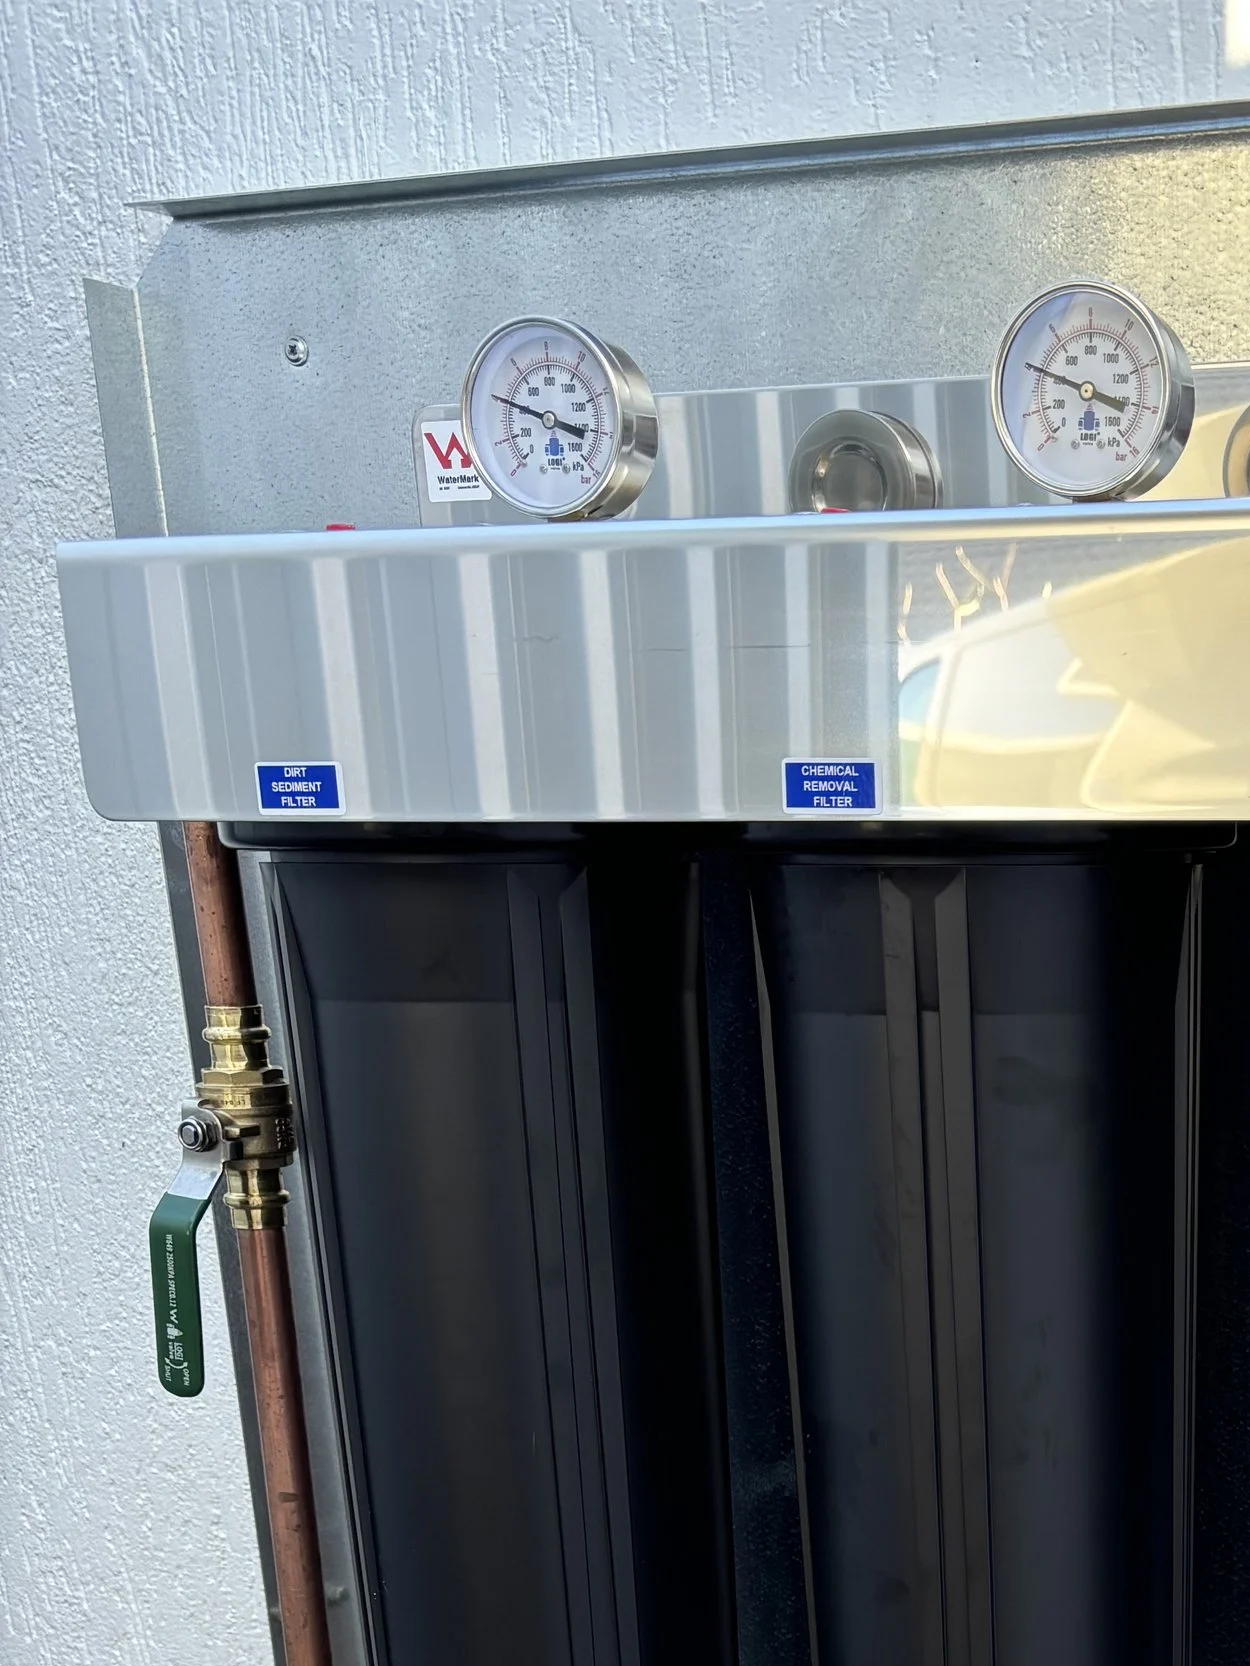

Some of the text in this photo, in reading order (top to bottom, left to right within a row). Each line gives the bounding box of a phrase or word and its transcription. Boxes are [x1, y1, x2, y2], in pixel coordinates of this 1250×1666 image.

[1084, 345, 1097, 356] 800
[1066, 355, 1078, 366] 600
[1103, 353, 1119, 364] 1000
[544, 377, 556, 386] 800
[1112, 373, 1129, 384] 1200
[528, 387, 539, 397] 600
[561, 384, 576, 394] 1000
[571, 402, 586, 412] 1200
[1053, 399, 1065, 410] 200
[1061, 417, 1066, 427] 0
[1104, 416, 1121, 427] 1600
[520, 428, 532, 437] 200
[568, 442, 583, 452] 1600
[1107, 437, 1120, 448] kPa
[529, 445, 534, 453] 0
[1115, 452, 1127, 462] bar
[573, 462, 585, 472] kPa
[437, 474, 480, 485] WaterMark
[581, 475, 591, 485] bar
[284, 767, 307, 778] DIRT
[801, 765, 859, 776] CHEMICAL
[271, 781, 322, 792] SEDIMENT
[803, 781, 858, 791] REMOVAL
[281, 796, 317, 807] FILTER
[813, 796, 852, 807] FILTER
[183, 1368, 191, 1386] OPEN
